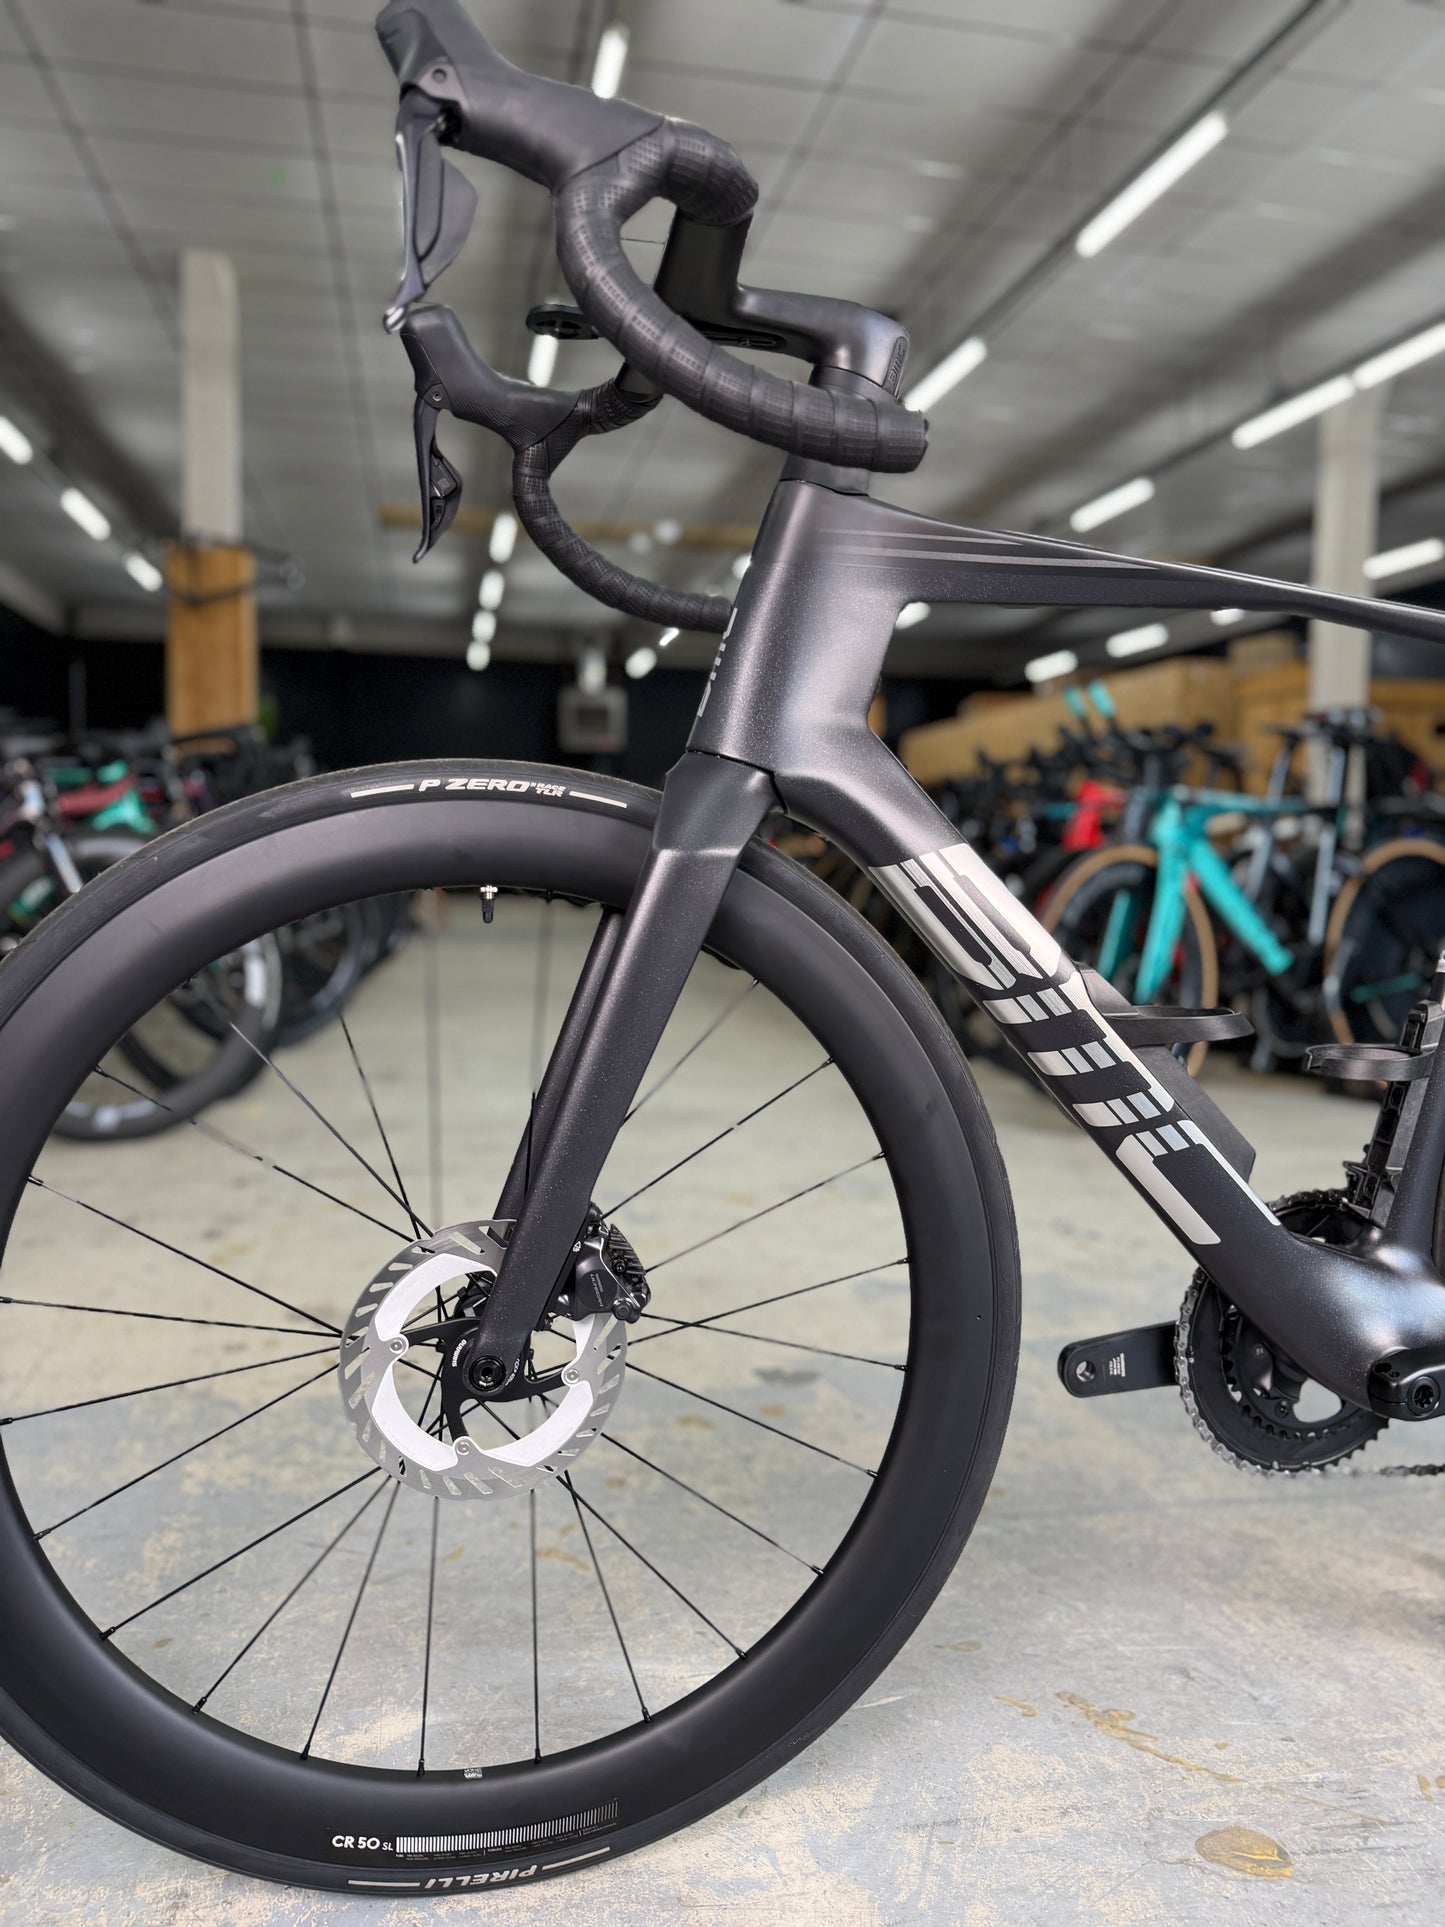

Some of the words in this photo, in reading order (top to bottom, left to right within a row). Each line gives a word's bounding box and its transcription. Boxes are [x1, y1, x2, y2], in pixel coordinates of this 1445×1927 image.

[888, 344, 905, 383] BMC
[418, 778, 441, 792] P
[444, 777, 531, 793] ZERO
[536, 782, 567, 792] RACE
[535, 787, 563, 798] TLR
[867, 842, 1282, 1246] BMC
[331, 1834, 355, 1850] CR
[358, 1835, 381, 1850] 50
[381, 1842, 394, 1851] SL
[425, 1864, 538, 1889] PIRELLI
